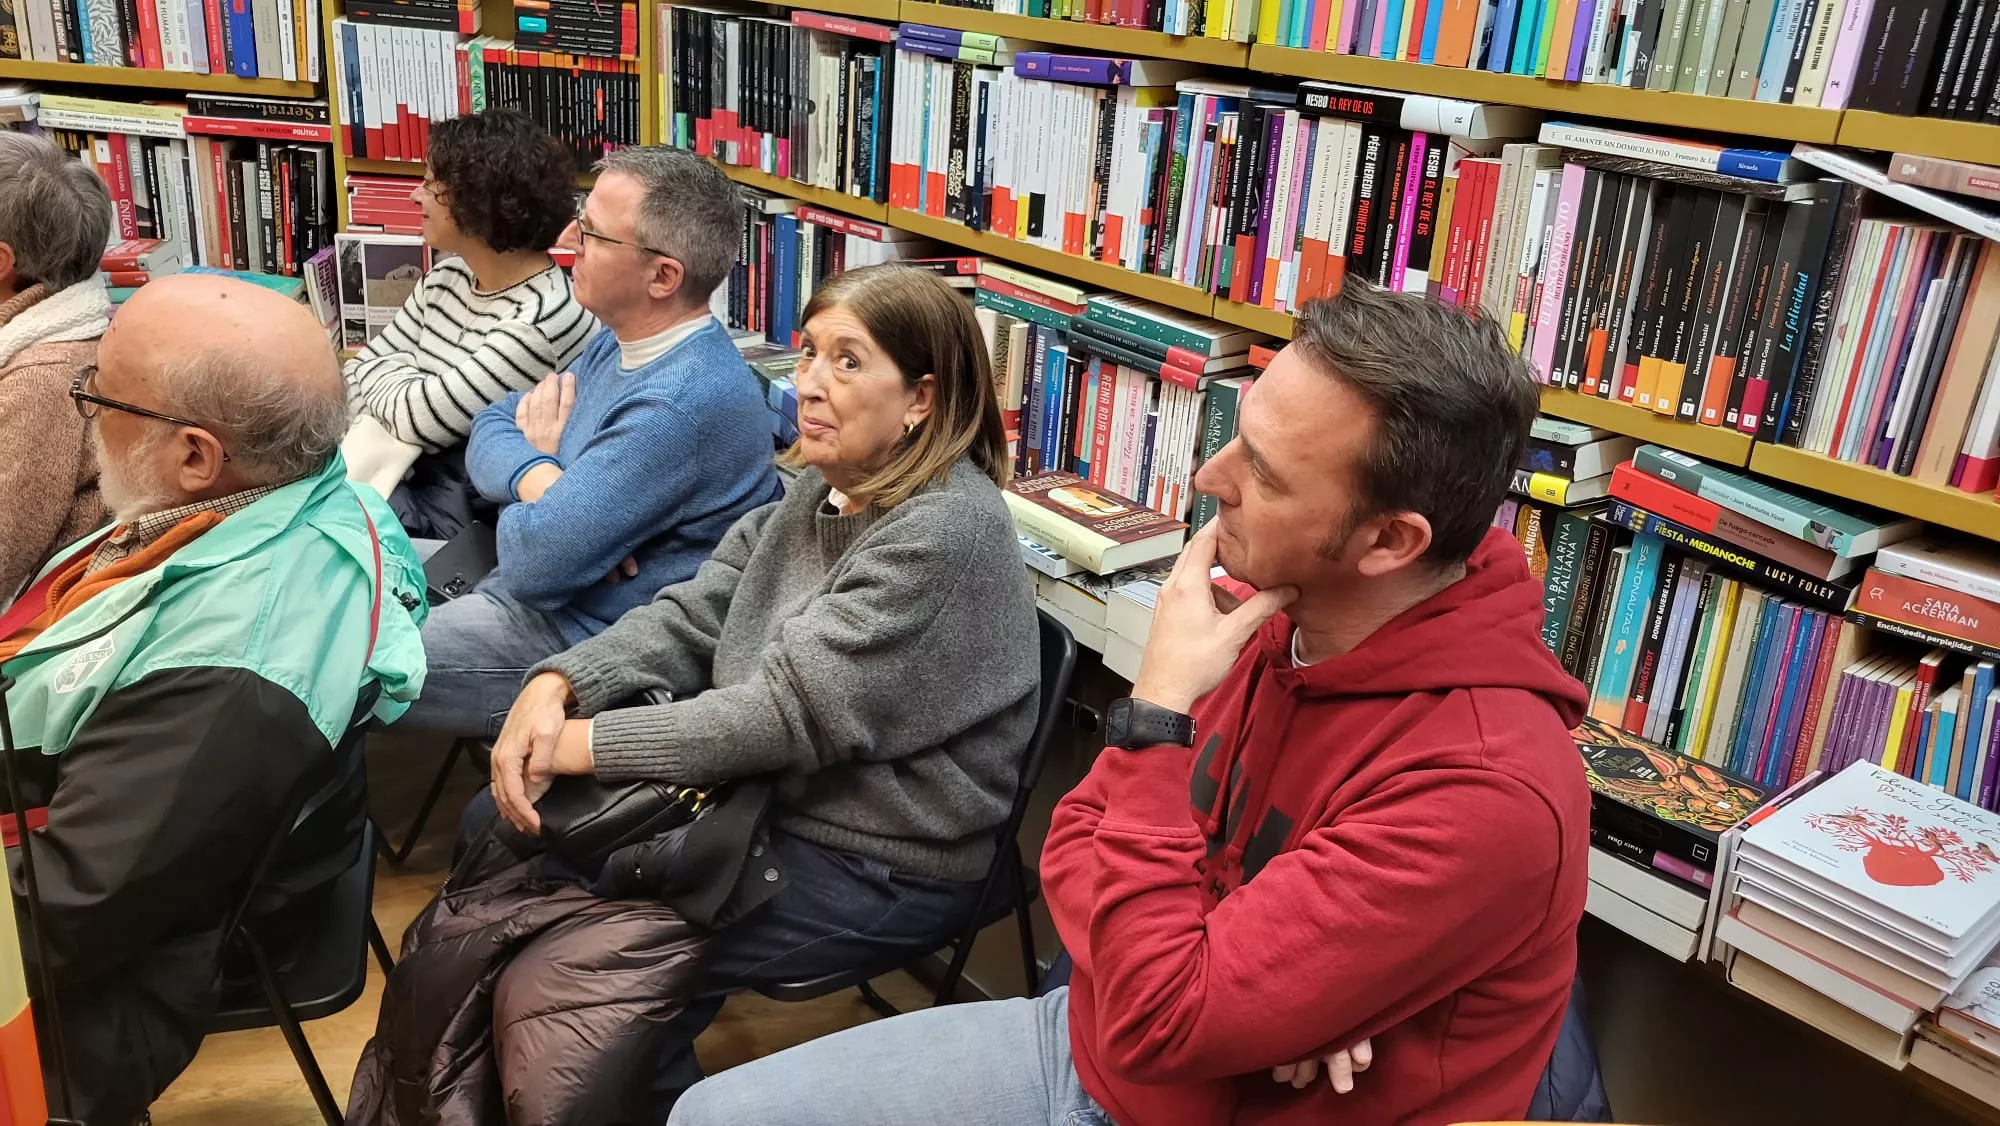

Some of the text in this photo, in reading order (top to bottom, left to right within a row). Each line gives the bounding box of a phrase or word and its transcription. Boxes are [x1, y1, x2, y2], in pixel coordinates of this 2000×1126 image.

[160, 7, 171, 45] HUMANO
[1810, 45, 1823, 71] WALTER
[1934, 72, 1946, 95] VICENT
[1970, 69, 1984, 99] CHARLES
[261, 106, 315, 121] Serrat
[1306, 94, 1374, 114] NESBO EL REY DE OS
[292, 128, 319, 137] POLÍTICA
[1564, 134, 1572, 142] EL
[1572, 135, 1603, 146] AMANTE
[1603, 140, 1615, 148] SIN
[1615, 142, 1655, 154] DOMICILIO
[1655, 149, 1670, 158] FIJO
[1412, 144, 1420, 164] IRENE
[1737, 162, 1759, 172] Siruela
[948, 158, 956, 196] NEGRO
[955, 150, 964, 198] CORAZÓN
[1417, 148, 1440, 236] NESBO EL REY DE OS
[1336, 192, 1346, 224] CAZADOR
[1352, 134, 1380, 255] PÉREZ PIRINEO NOIR
[120, 199, 134, 237] ÚNICAS
[1539, 201, 1570, 325] EL DESCONTENTO
[1553, 232, 1572, 300] BEATRIZ SERRANO
[1779, 271, 1809, 353] La felicidad
[1098, 373, 1111, 433] REINA ROJA
[1210, 407, 1222, 457] ALARICO
[1520, 507, 1544, 556] LANGOSTA
[1653, 523, 1757, 571] FIESTA MEDIANOCHE
[1718, 517, 1776, 545] De fuego cercada
[1544, 521, 1575, 613] LA BAILARINA
[1584, 530, 1603, 572] ANHELOS
[1555, 540, 1580, 601] ITALIANA
[1619, 543, 1651, 636] SALTONAUTAS
[1764, 565, 1836, 601] LUCY FOLEY
[1902, 601, 1979, 629] ACKERMAN
[1924, 597, 1961, 615] SARA
[1636, 562, 1676, 696] JUNGSTEDT DONDE MUERE LA LUZ
[1876, 621, 1974, 653] Enciclopedia perplejidad
